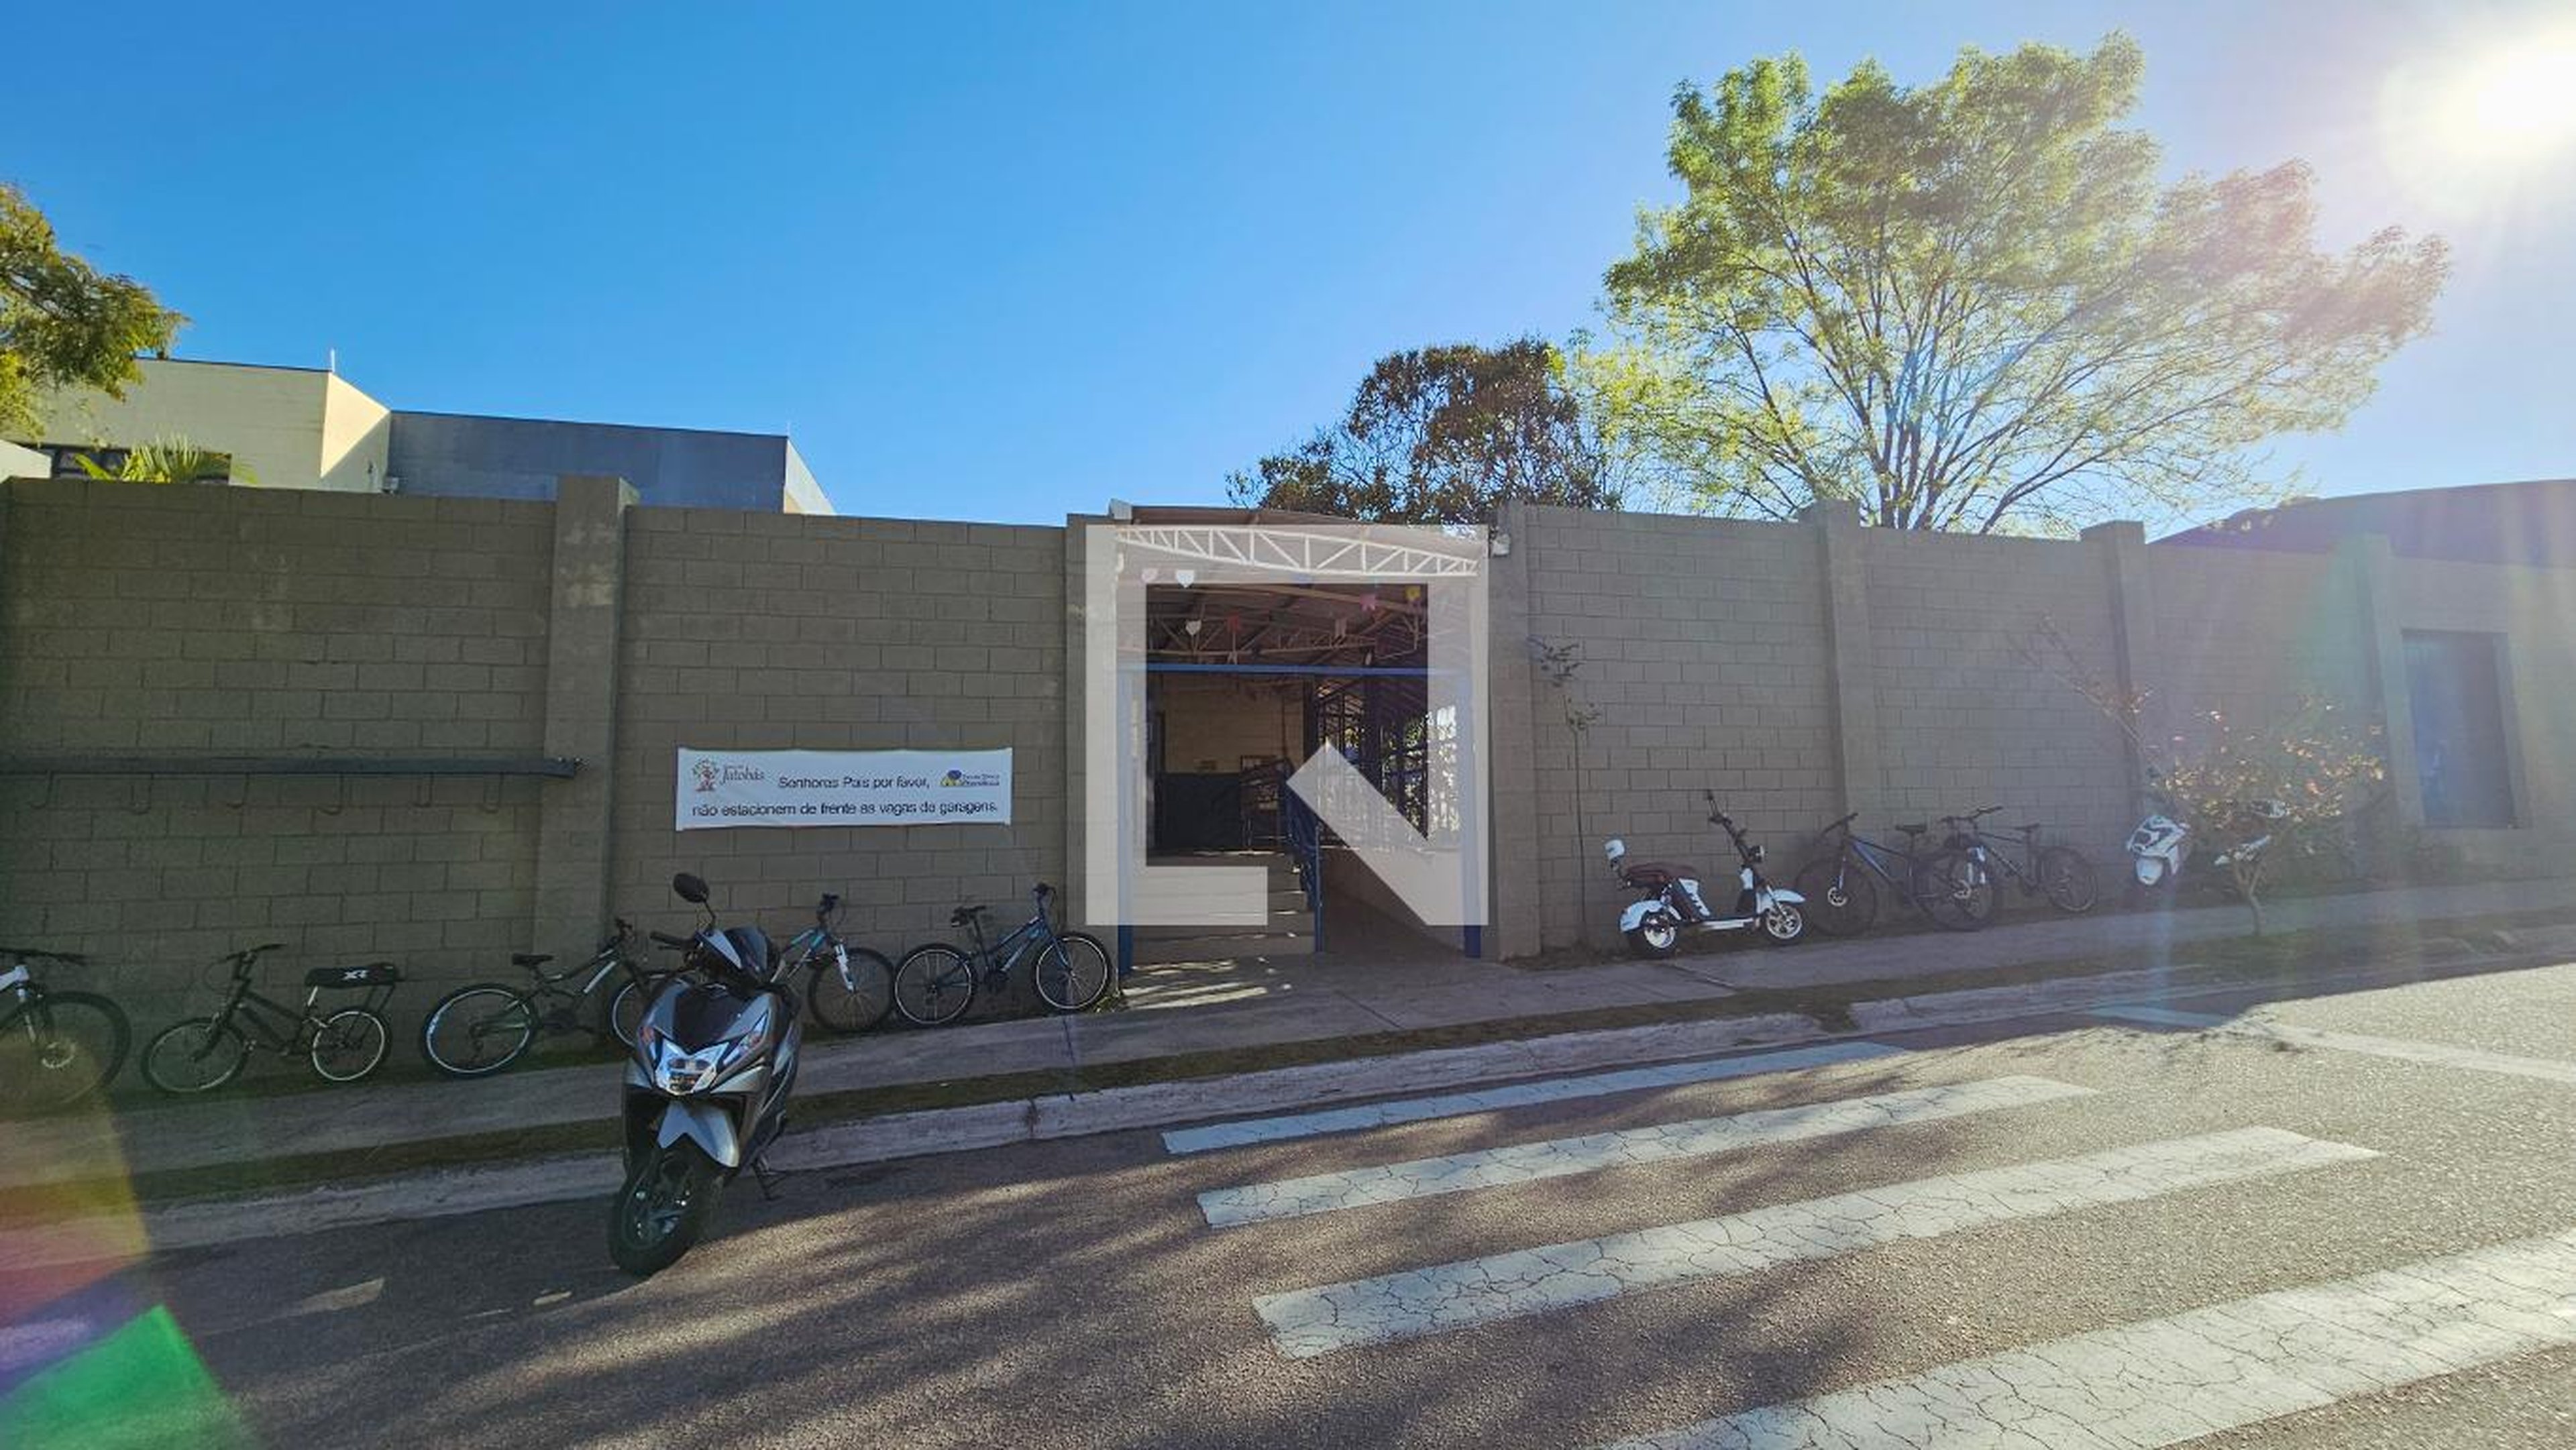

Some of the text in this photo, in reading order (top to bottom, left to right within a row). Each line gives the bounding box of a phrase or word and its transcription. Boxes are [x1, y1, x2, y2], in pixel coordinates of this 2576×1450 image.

[874, 777, 893, 789] por
[692, 805, 718, 816] não
[721, 804, 797, 816] estacionem
[800, 803, 816, 814] de
[820, 802, 857, 814] frente
[879, 803, 918, 816] vagas
